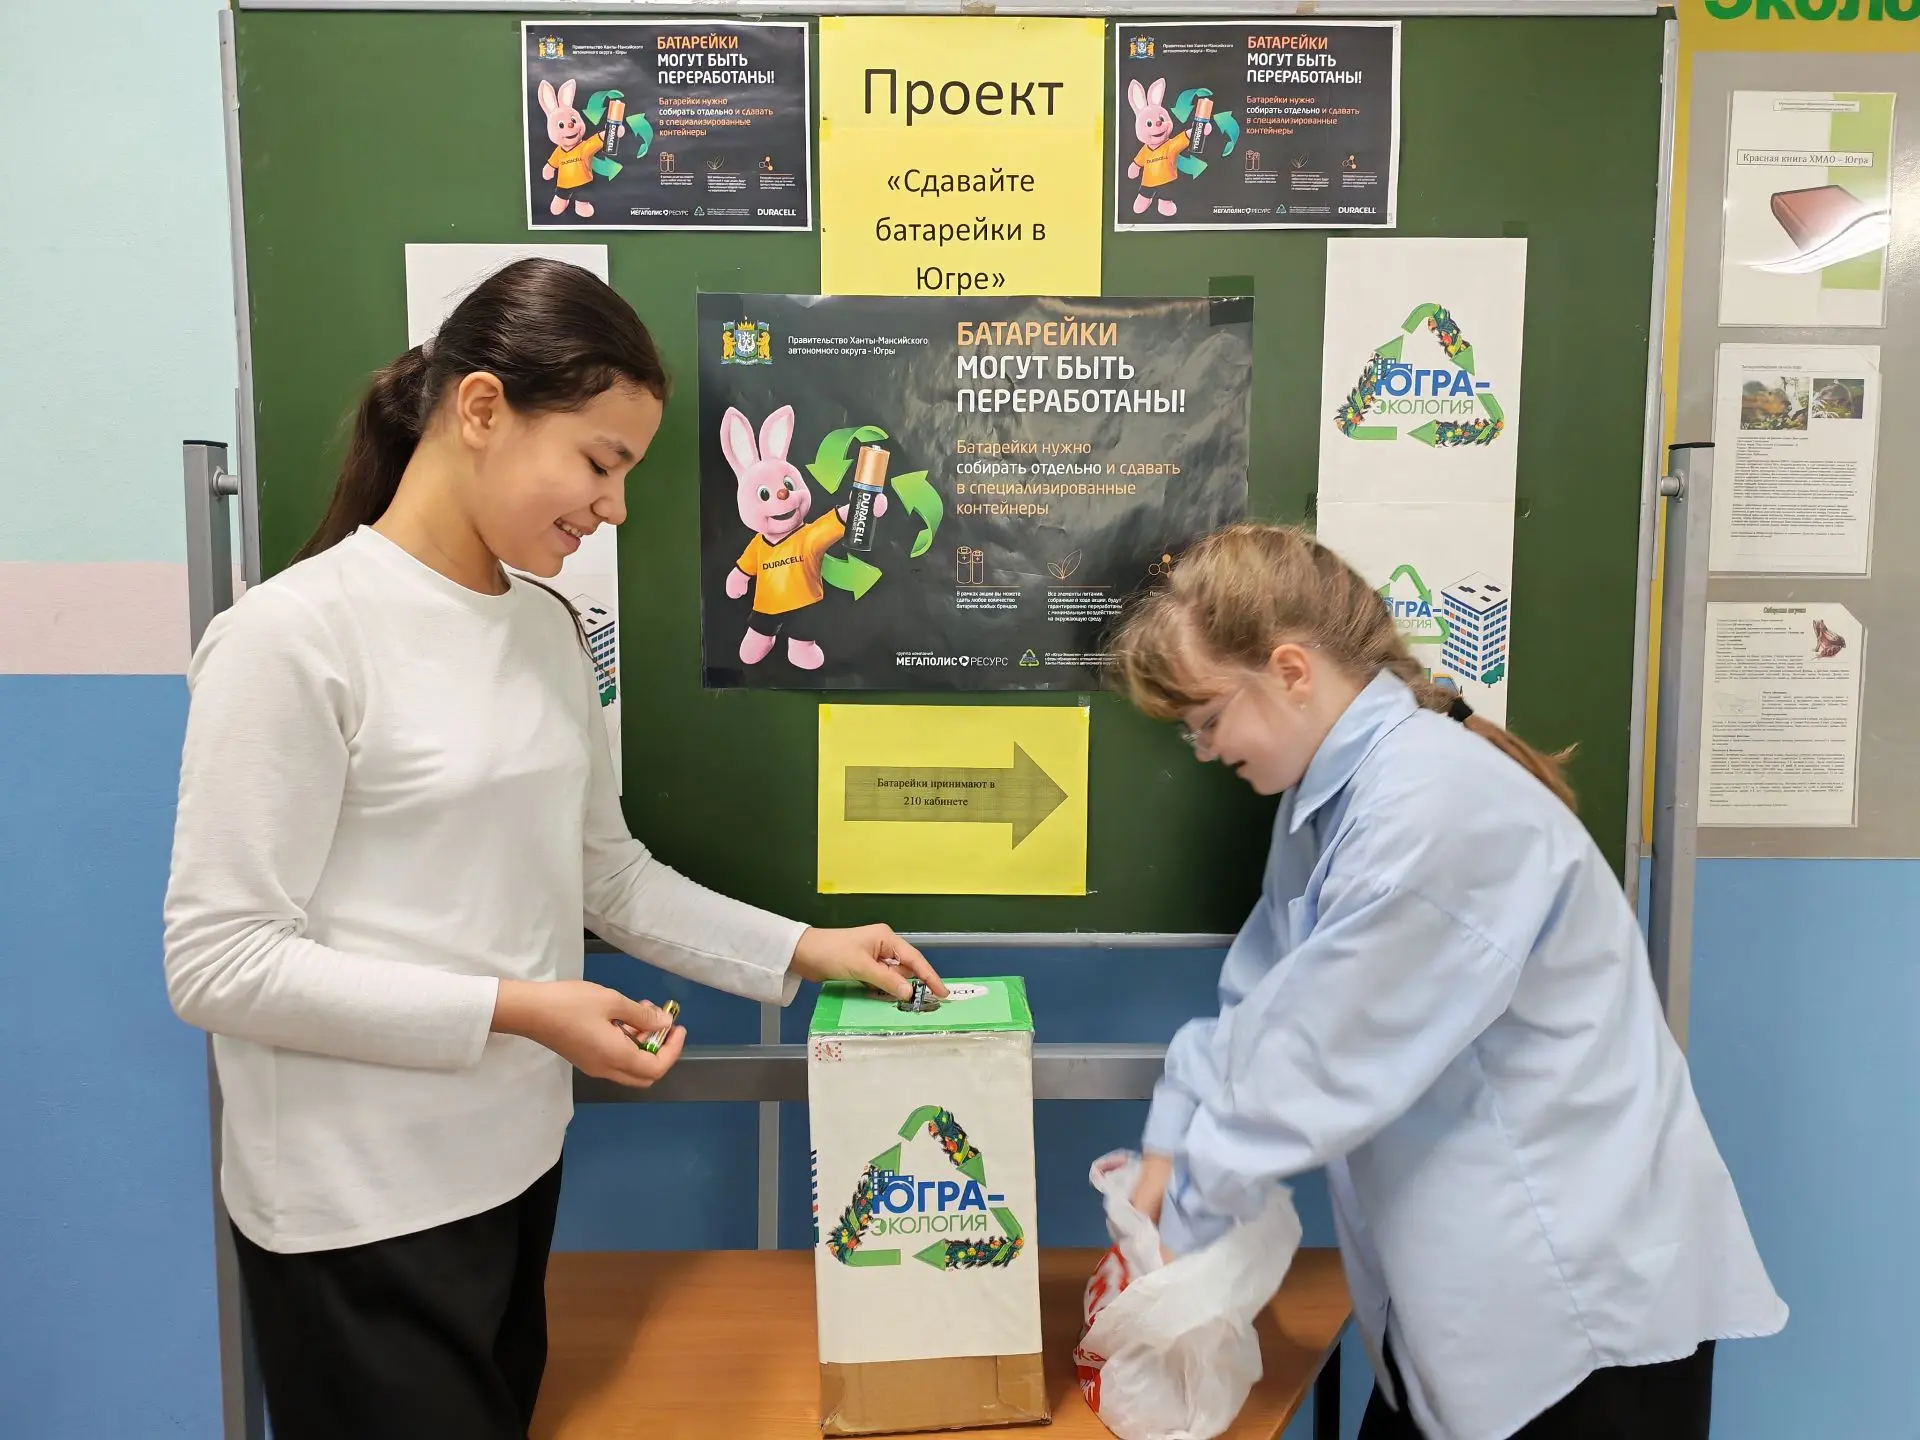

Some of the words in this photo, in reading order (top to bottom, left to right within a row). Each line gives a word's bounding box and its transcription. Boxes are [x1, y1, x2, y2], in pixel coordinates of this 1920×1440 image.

[657, 33, 739, 50] БАТАРЕЙКИ
[1247, 34, 1328, 49] БАТАРЕЙКИ
[657, 53, 704, 67] МОГУТ
[708, 53, 748, 67] БЫТЬ
[1247, 53, 1293, 66] МОГУТ
[1296, 54, 1337, 67] БЫТЬ
[658, 70, 775, 84] ПЕРЕРАБОТАНЫ!
[1246, 69, 1362, 84] ПЕРЕРАБОТАНЫ!
[659, 97, 701, 106] Батарейки
[701, 98, 728, 107] нужно
[864, 68, 1064, 126] Проект
[1246, 95, 1288, 105] Батарейки
[1289, 97, 1315, 105] нужно
[659, 108, 695, 116] собирать
[697, 108, 733, 116] отдельно
[1246, 106, 1282, 115] собирать
[1283, 107, 1320, 115] отдельно
[665, 119, 751, 127] специализированные
[1252, 117, 1338, 125] специализированные
[659, 129, 707, 137] контейнеры
[1246, 126, 1294, 136] контейнеры
[1743, 153, 1779, 164] Красная
[1781, 155, 1807, 163] книга
[1809, 154, 1836, 164] ХМАО
[1844, 155, 1869, 164] Югра
[887, 167, 1035, 198] «Сдавайте
[757, 208, 797, 216] DURACELL
[1338, 206, 1377, 214] DURACELL
[875, 216, 1022, 247] батарейки
[1032, 222, 1046, 241] в
[917, 266, 1006, 295] Югре»
[957, 316, 1117, 347] БАТАРЕЙКИ
[788, 336, 849, 345] Правительство
[849, 336, 929, 345] Ханты-Мансийского
[788, 347, 839, 355] автономного
[840, 348, 867, 356] округа
[873, 346, 896, 356] Югры
[957, 355, 1049, 380] МОГУТ
[1057, 356, 1135, 380] БЫТЬ
[1375, 364, 1490, 397] ЮГРА-
[957, 388, 1186, 413] ПЕРЕРАБОТАНЫ!
[1372, 399, 1474, 415] ЭКОЛОГИЯ
[957, 440, 1037, 457] Батарейки
[1042, 442, 1092, 457] нужно
[956, 460, 1027, 477] собирать
[1031, 463, 1102, 476] отдельно
[1106, 464, 1115, 474] и
[1119, 463, 1181, 476] сдавать
[957, 484, 965, 495] в
[969, 483, 1136, 497] специализированные
[957, 500, 1049, 516] контейнеры
[853, 493, 871, 544] DURACELL
[762, 555, 804, 571] DURACELL
[896, 656, 958, 666] МЕГАПОЛИС
[970, 656, 1009, 666] РЕСУРС
[877, 777, 928, 789] Батарейки
[930, 779, 987, 790] принимают
[989, 781, 995, 789] в
[903, 796, 922, 807] 210
[924, 797, 969, 807] кабинете
[872, 1173, 1005, 1215] ЮГРА-
[870, 1214, 987, 1236] ЭКОЛОГИЯ
